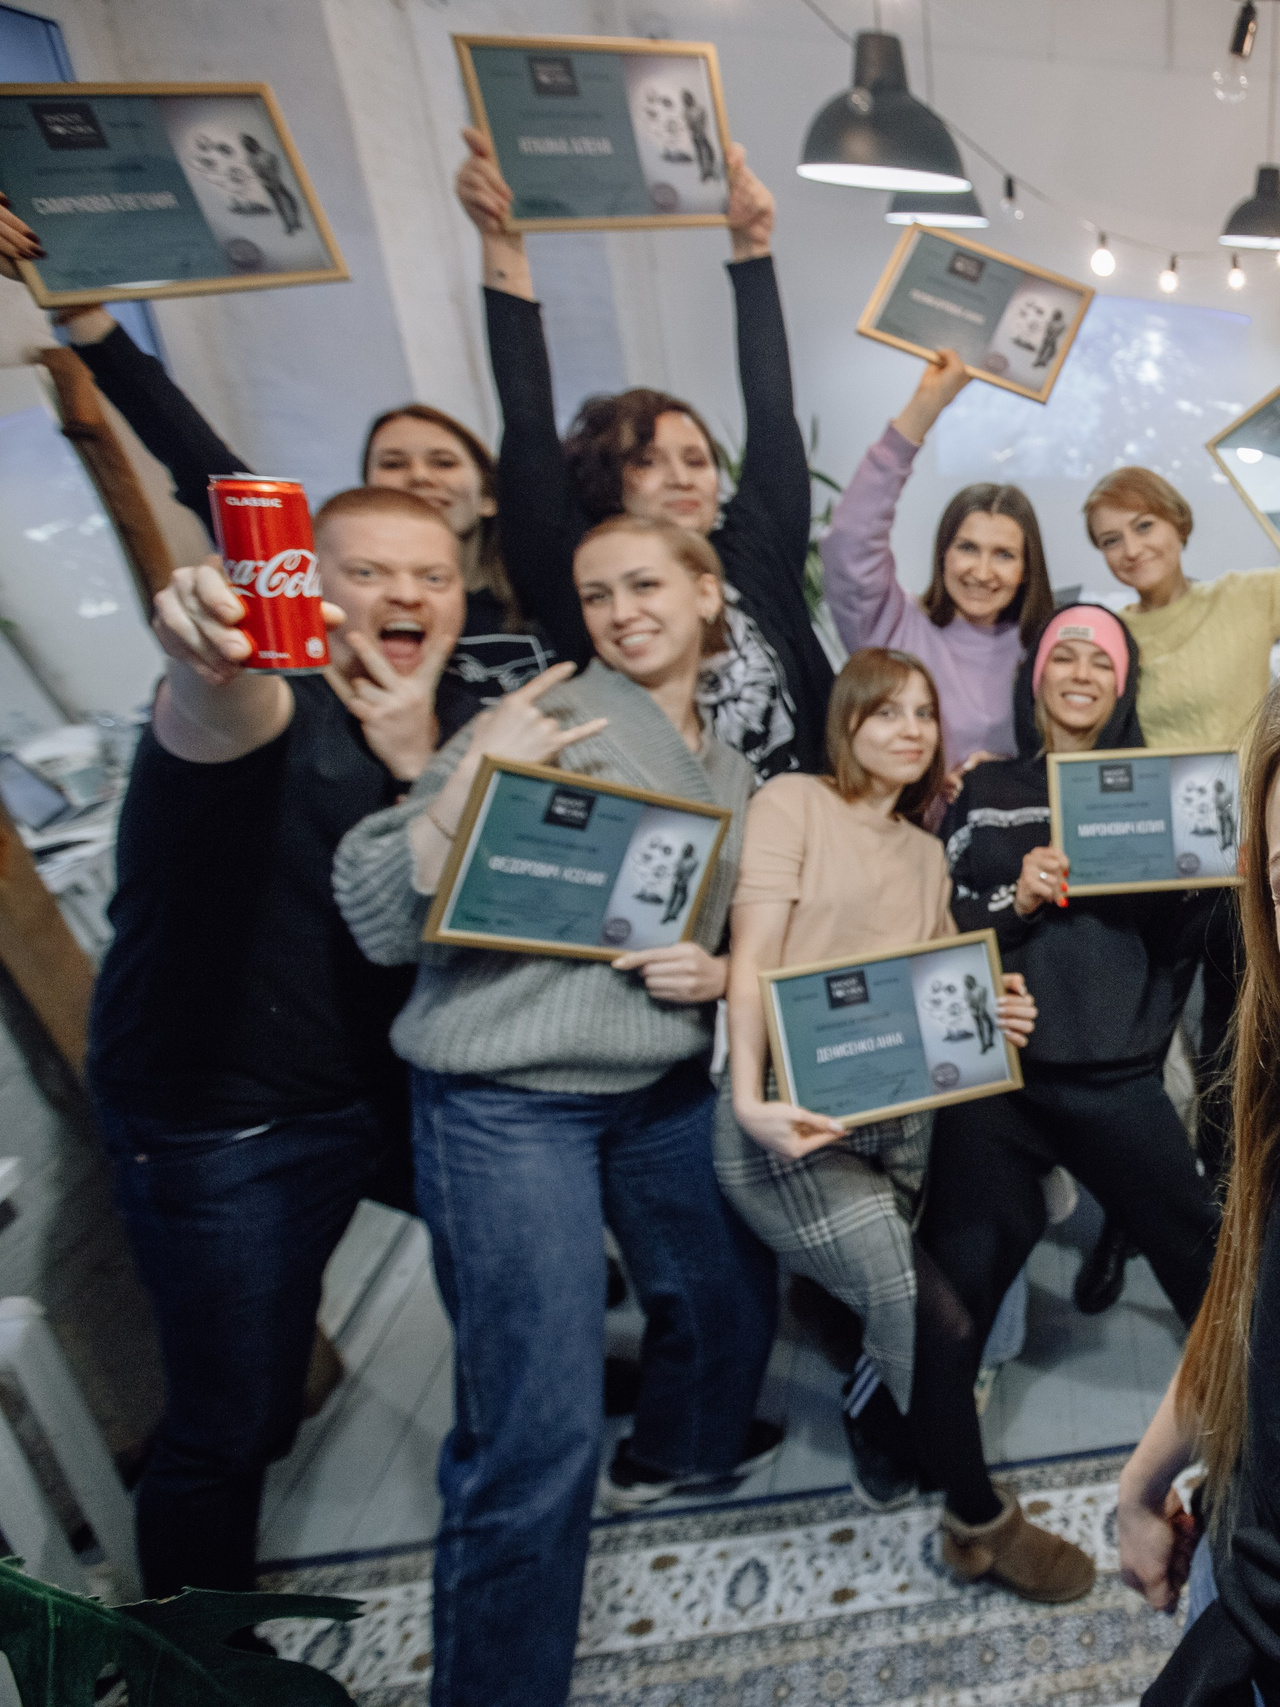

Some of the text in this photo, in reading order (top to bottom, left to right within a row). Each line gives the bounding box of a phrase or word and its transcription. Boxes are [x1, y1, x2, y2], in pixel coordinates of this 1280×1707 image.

[225, 496, 283, 509] CLASSIC
[1078, 819, 1166, 838] МИРОНОВИЧ ЮЛИЯ
[816, 1031, 904, 1064] ДЕНИСЕНКО АННА
